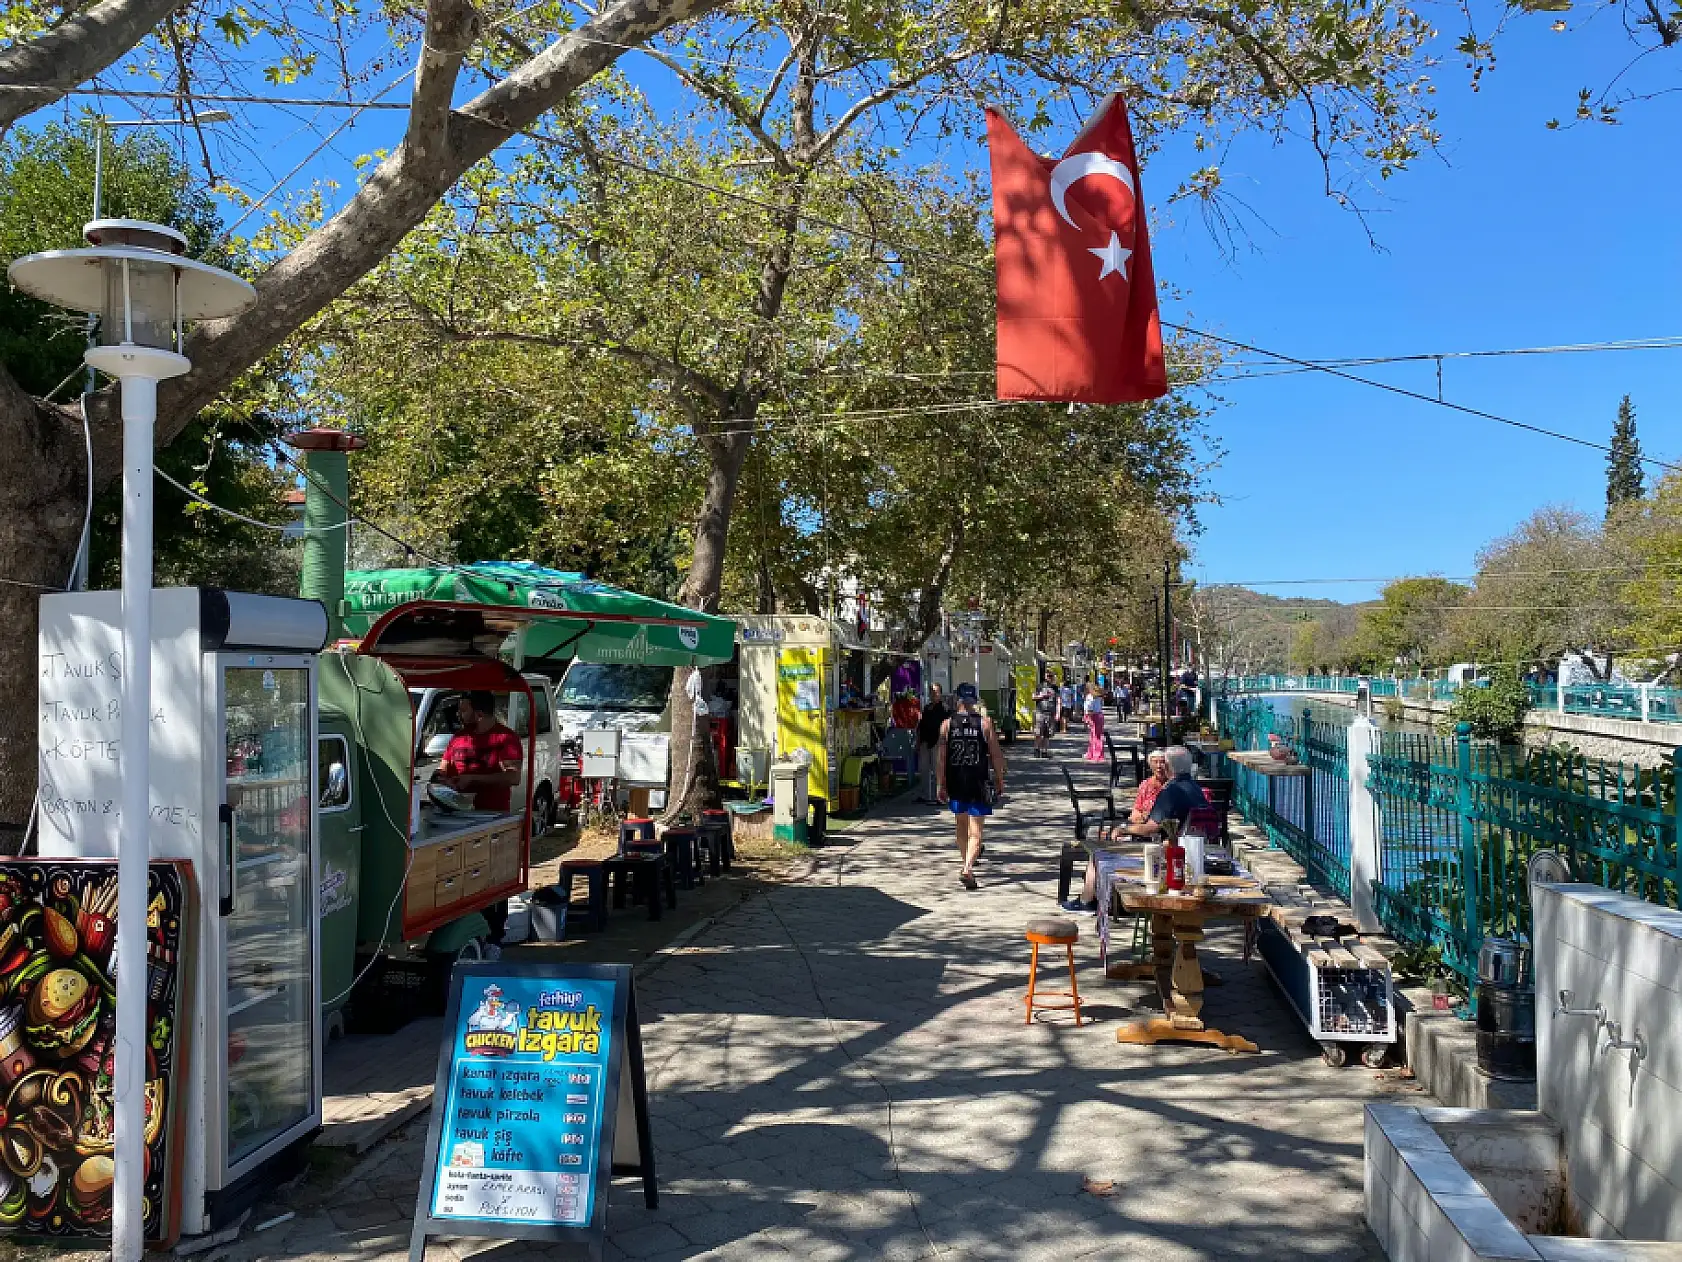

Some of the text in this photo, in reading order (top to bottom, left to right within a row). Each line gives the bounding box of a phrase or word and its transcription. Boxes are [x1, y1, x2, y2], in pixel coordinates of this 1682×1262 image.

[43, 652, 104, 679] TAVUK
[46, 700, 102, 723] TAVUK
[528, 1005, 601, 1032] tavuk
[466, 1033, 516, 1049] CHICKEN
[460, 1086, 495, 1100] tavuk
[457, 1107, 540, 1123] tavuk pirzola
[454, 1127, 489, 1140] tavuk
